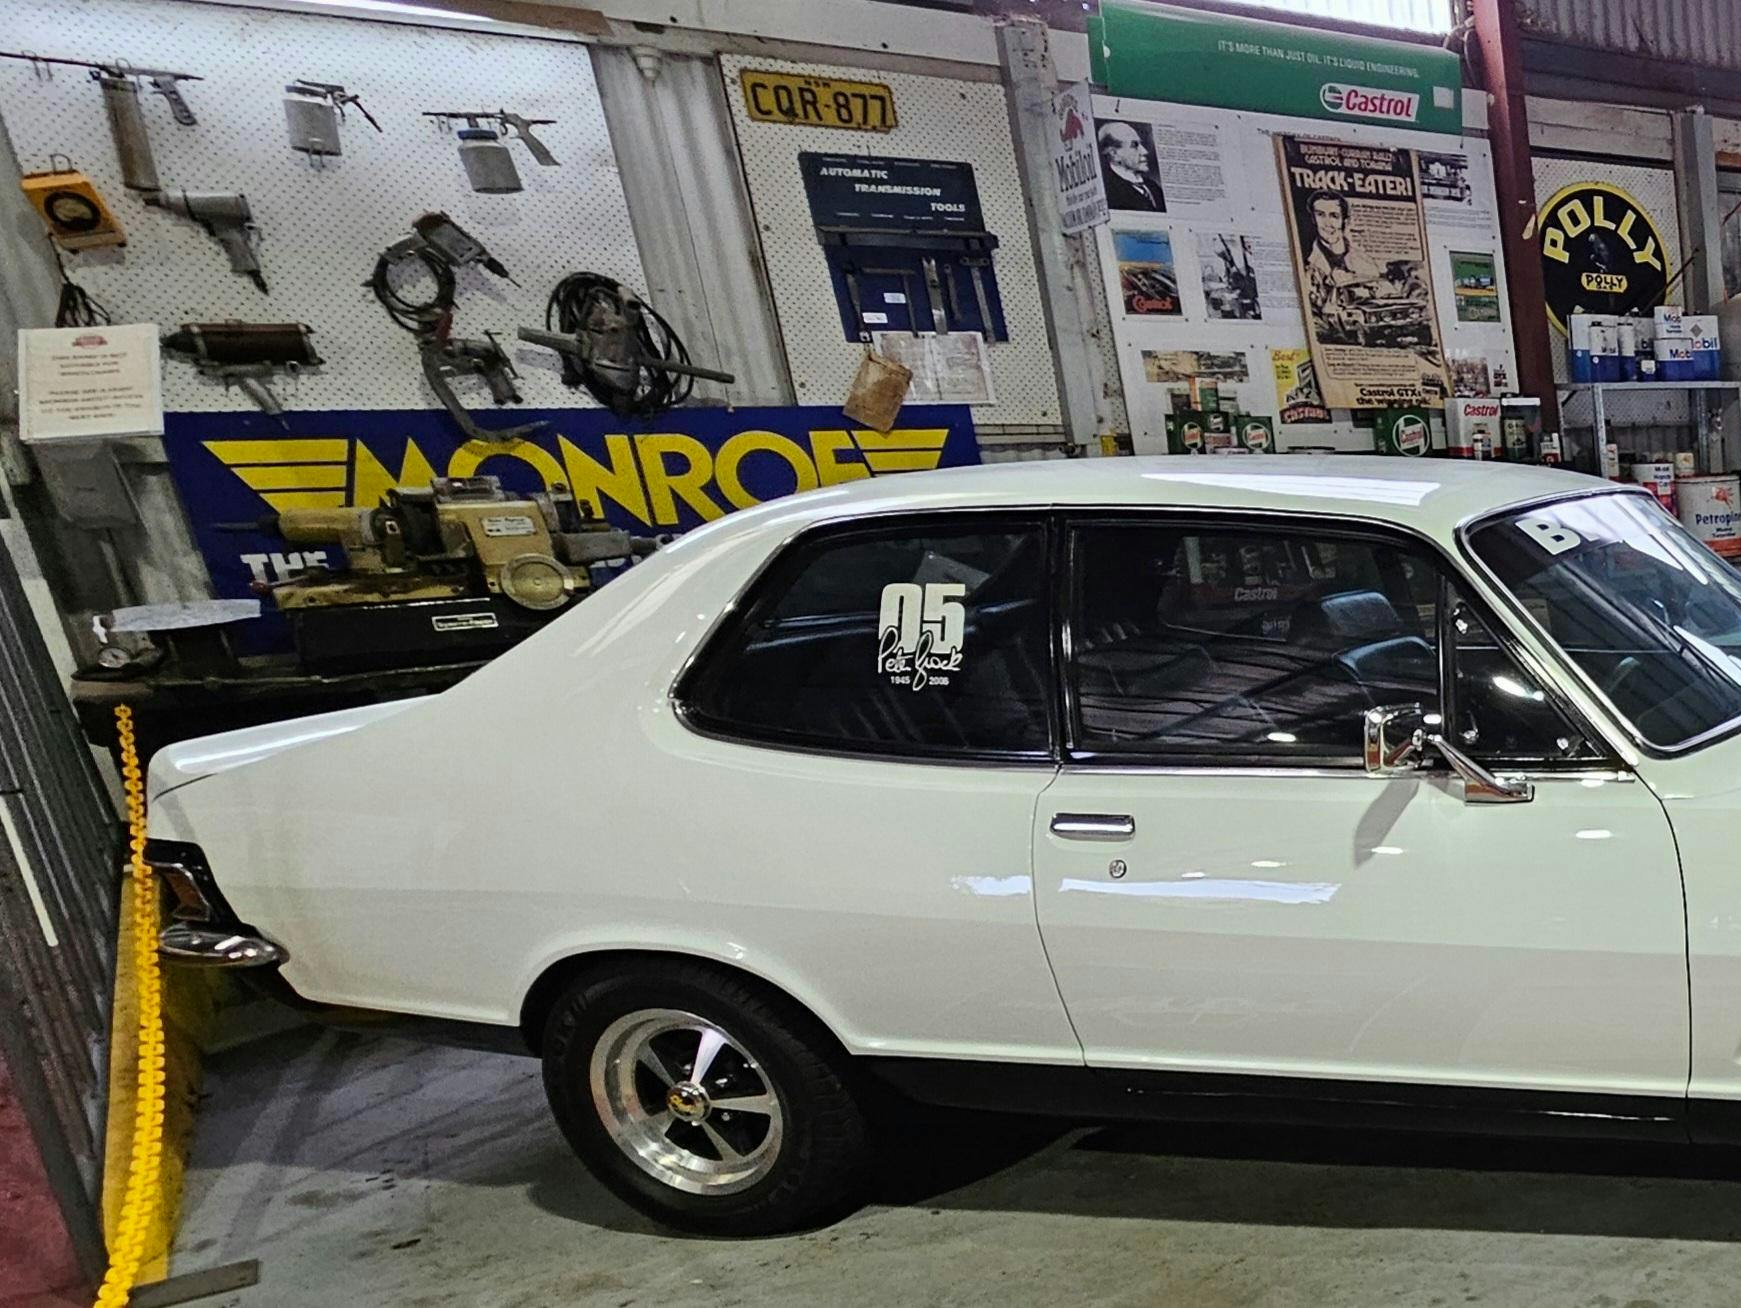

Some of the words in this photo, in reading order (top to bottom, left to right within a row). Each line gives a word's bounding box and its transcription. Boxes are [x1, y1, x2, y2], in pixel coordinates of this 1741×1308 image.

[1218, 40, 1234, 52] IT'S
[1235, 43, 1261, 56] MORE
[1262, 47, 1284, 59] THAN
[1286, 51, 1305, 62] JUST
[1323, 56, 1338, 67] IT'S
[751, 81, 887, 127] CQR-877
[1345, 88, 1412, 117] Castrol
[820, 167, 888, 179] AUTOMATIC
[854, 183, 941, 197] TRANSMISSION
[930, 202, 966, 212] TOOLS
[1543, 195, 1662, 271] POLLY
[1585, 274, 1623, 289] POLLY
[1464, 403, 1499, 417] Castrol
[878, 583, 966, 654] 05
[890, 675, 911, 685] 1945
